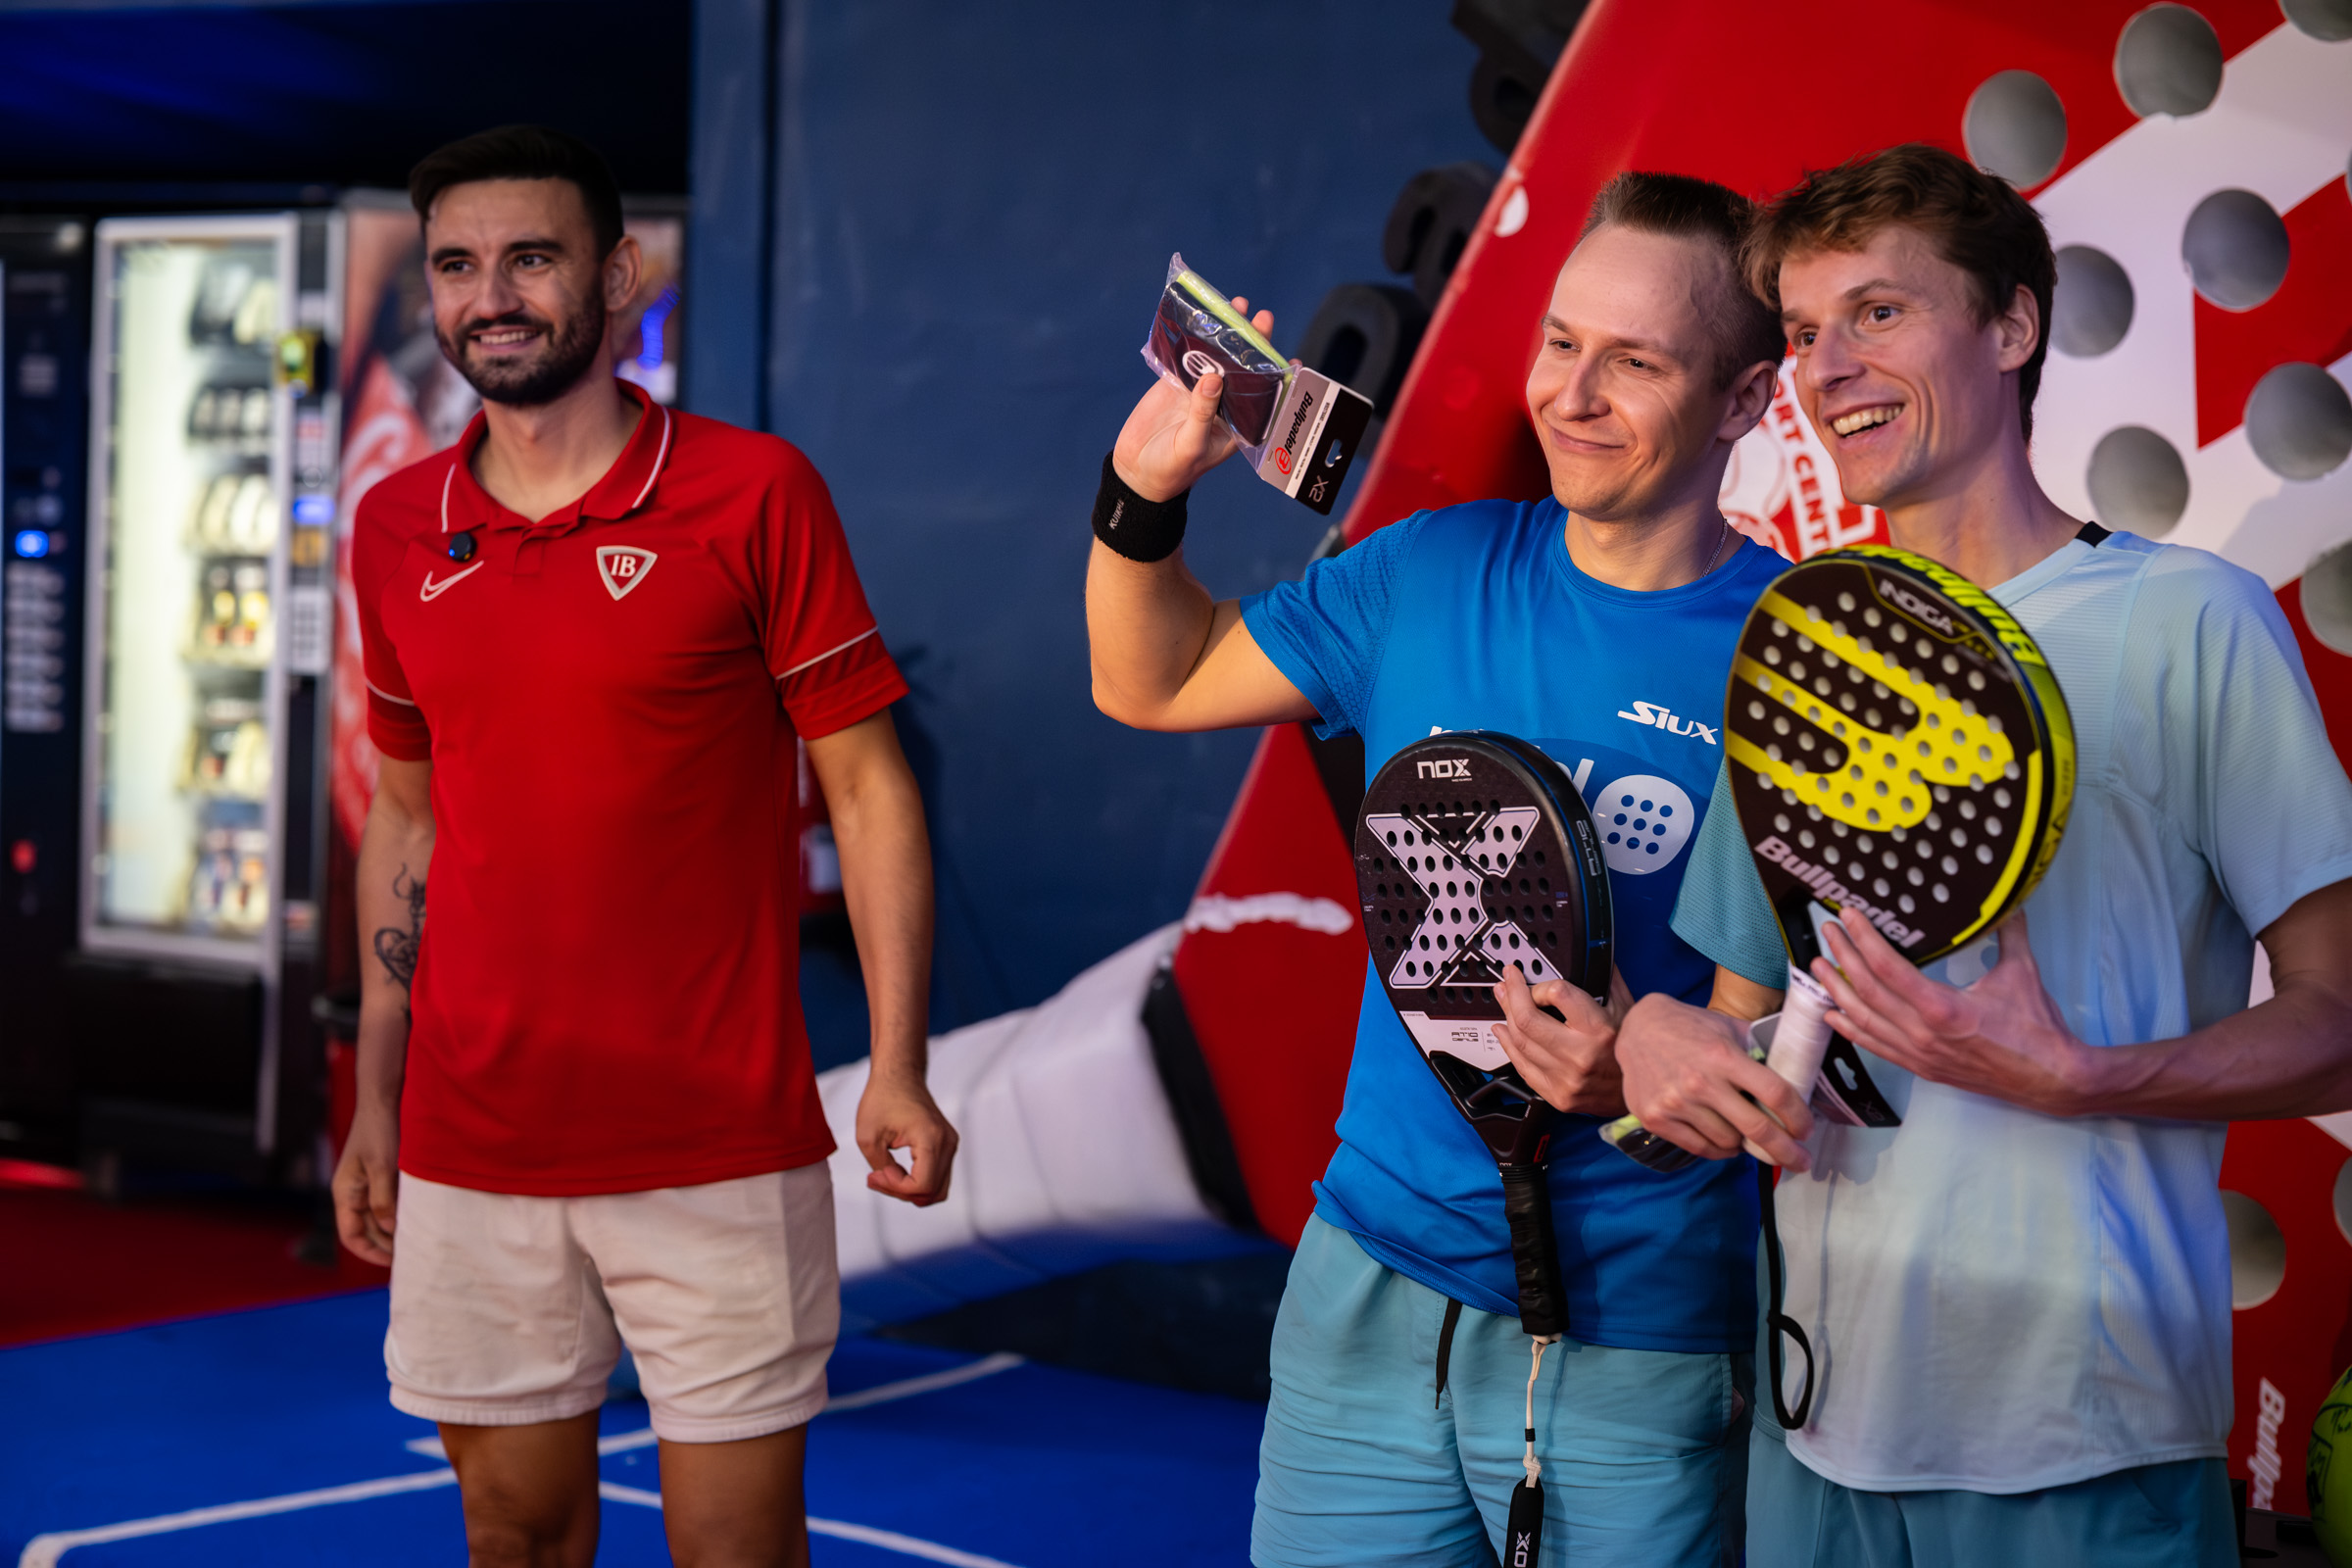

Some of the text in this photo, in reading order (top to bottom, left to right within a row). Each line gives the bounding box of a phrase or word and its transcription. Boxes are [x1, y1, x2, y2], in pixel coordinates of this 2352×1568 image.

[1285, 391, 1314, 456] Bullpadel
[1308, 474, 1330, 503] X2
[1793, 454, 1830, 543] CENT
[610, 554, 637, 577] IB
[1753, 834, 1926, 950] Bullpadel
[2246, 1376, 2286, 1511] Bullpa
